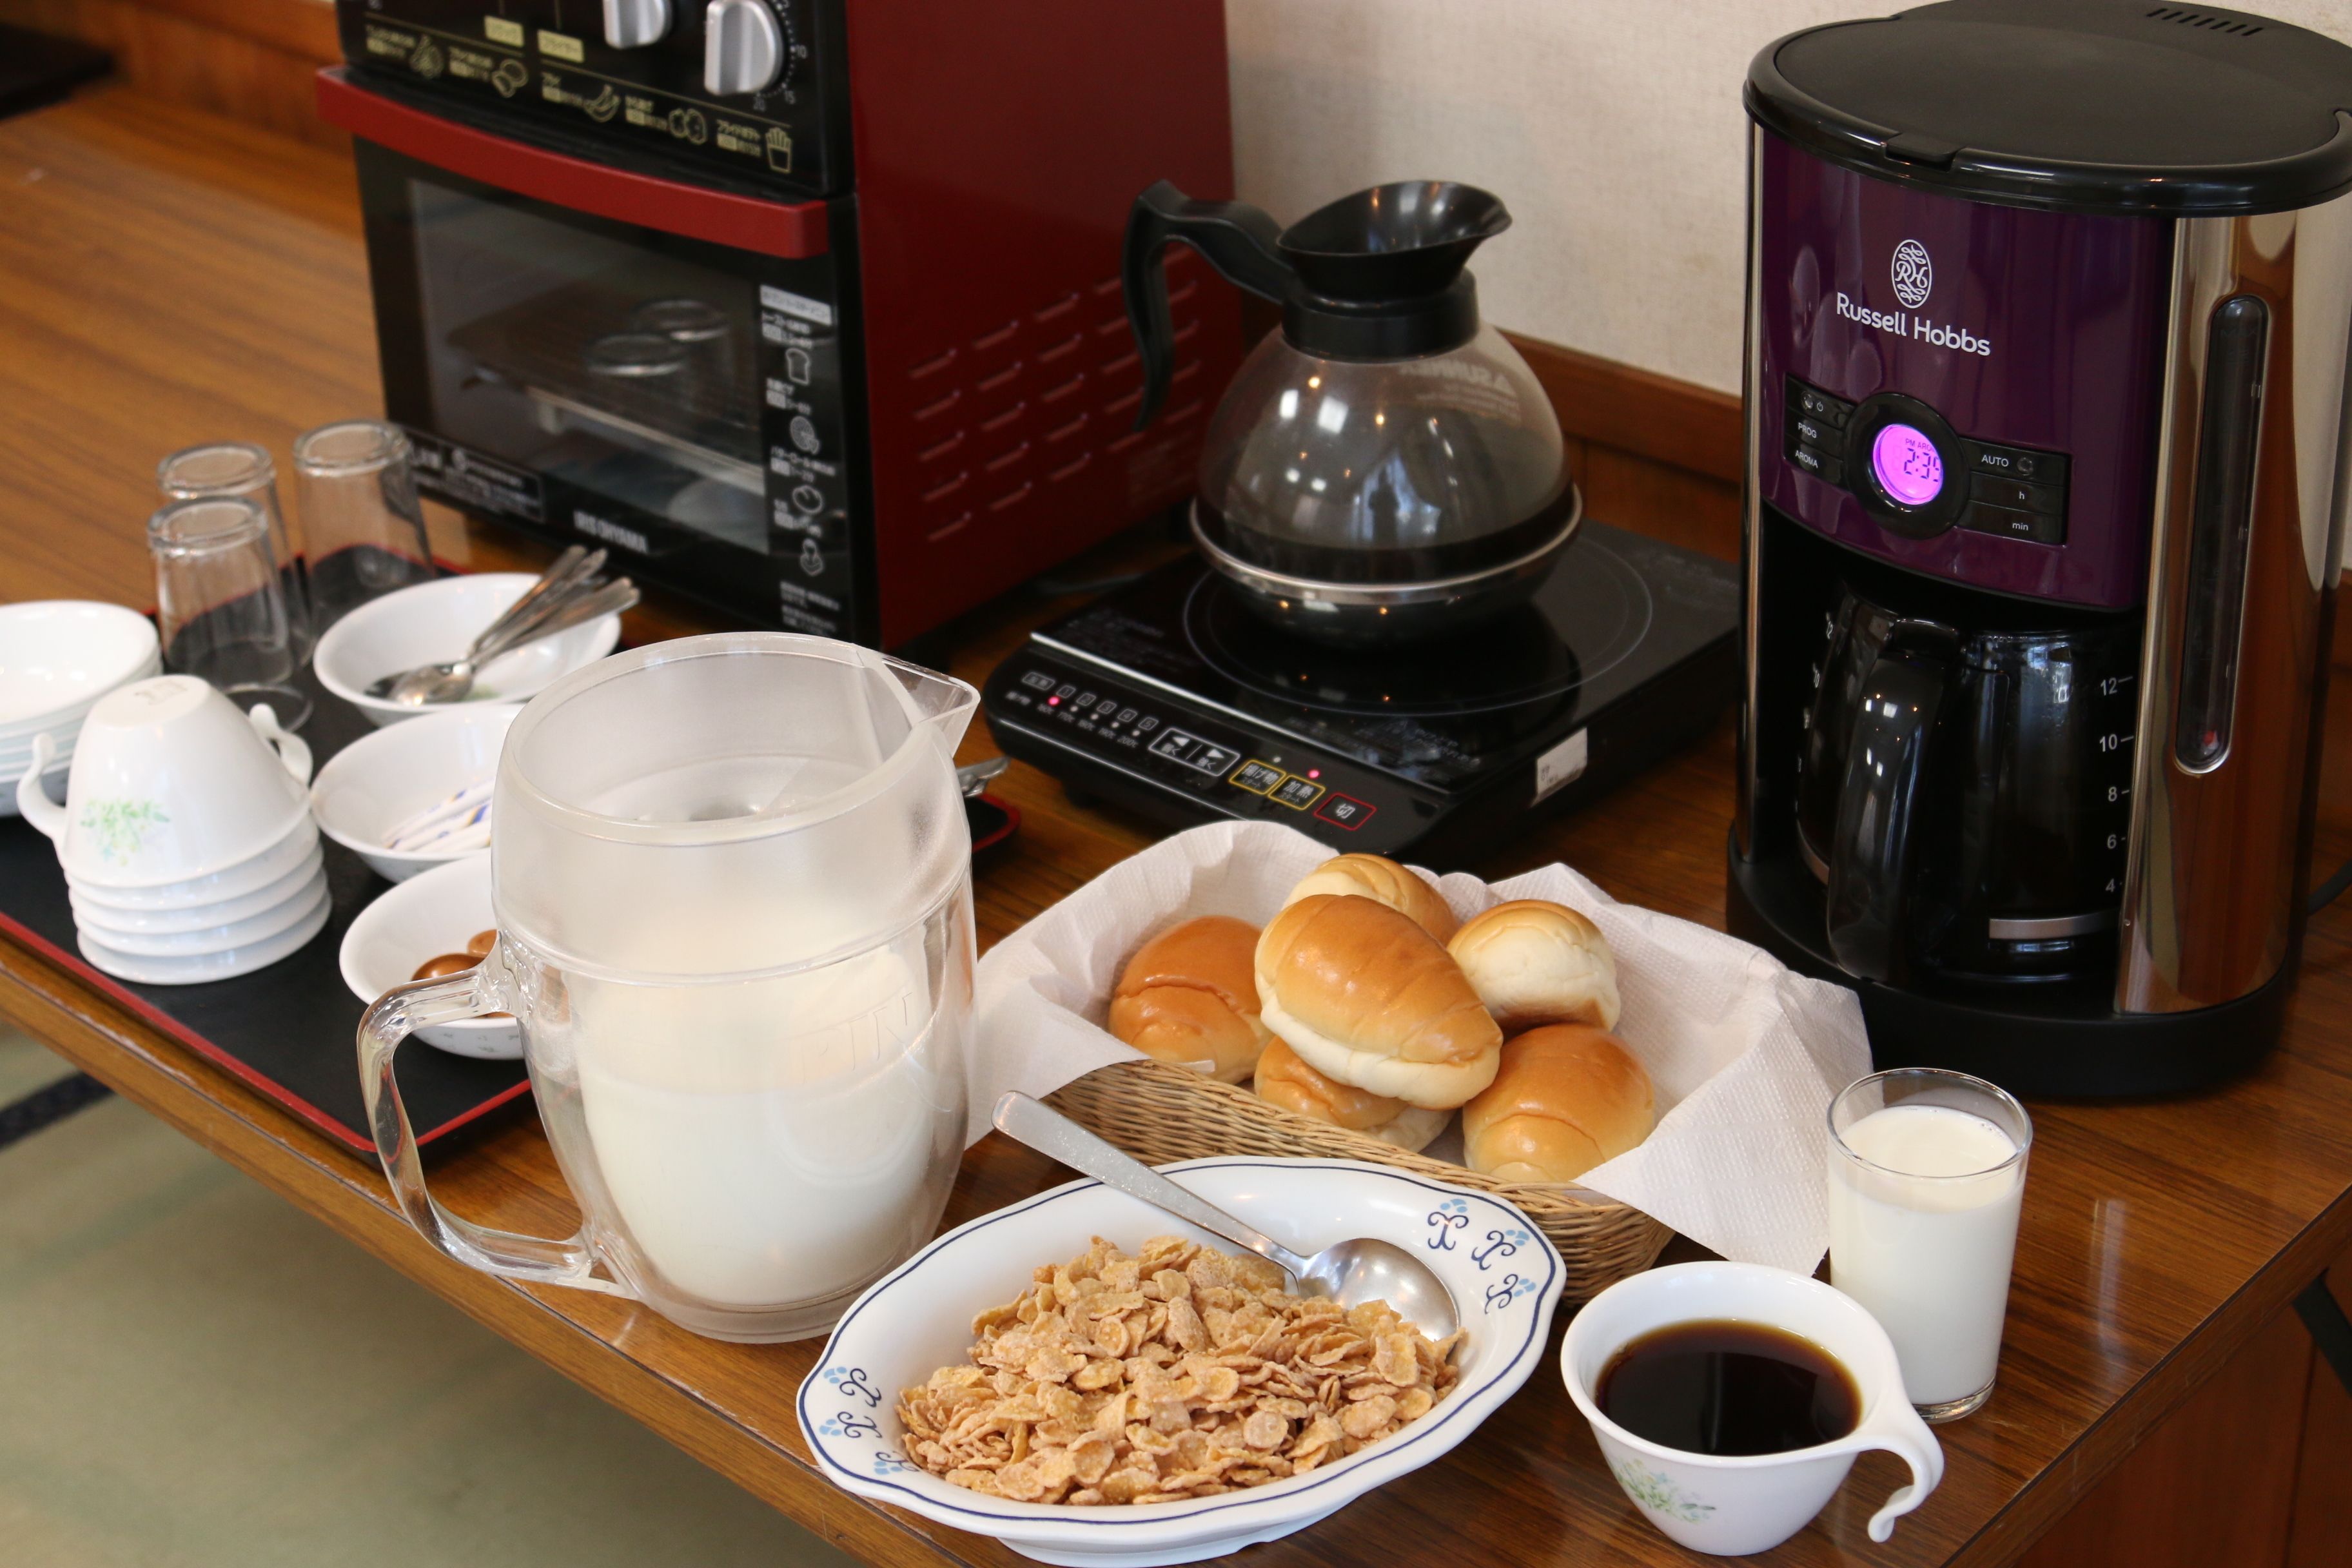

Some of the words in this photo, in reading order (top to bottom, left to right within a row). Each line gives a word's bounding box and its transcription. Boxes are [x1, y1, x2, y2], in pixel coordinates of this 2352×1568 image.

[796, 44, 807, 59] 10
[785, 91, 796, 104] 15
[1837, 291, 1906, 337] Russell
[1914, 316, 1991, 357] Hobbs
[1798, 422, 1817, 438] PROG
[1905, 438, 1916, 447] PM
[1917, 442, 1933, 451] ARO
[1795, 449, 1818, 469] AROMA
[1981, 454, 2009, 467] AUTO
[2019, 491, 2025, 500] h
[2012, 522, 2029, 531] min
[2100, 677, 2118, 696] 12
[2099, 734, 2118, 752] 10
[1242, 763, 1279, 785] 揚げ物
[1284, 780, 1315, 799] 加熱
[2108, 785, 2118, 802] 8
[1335, 802, 1356, 819] 切
[2106, 834, 2117, 850] 6
[2105, 877, 2115, 893] 4
